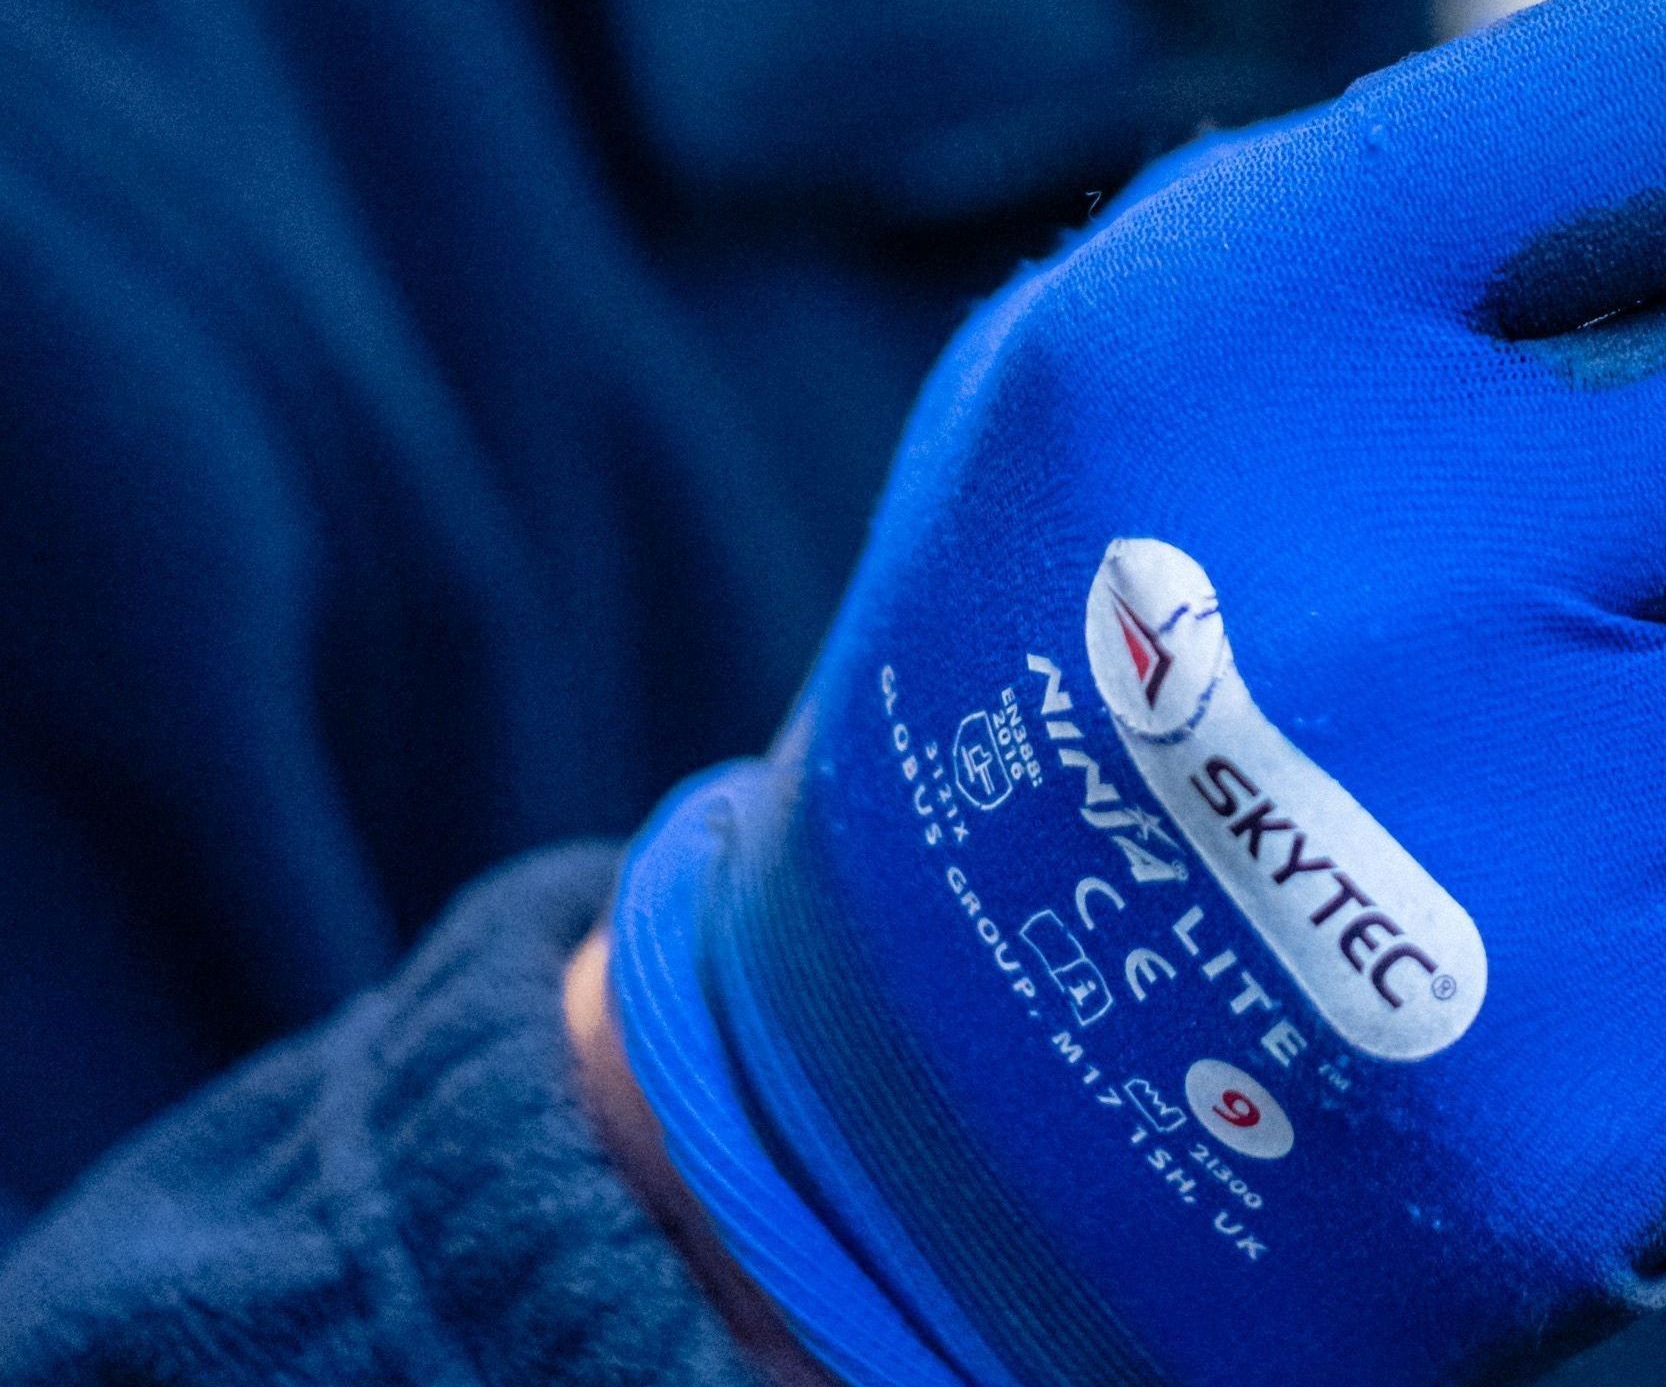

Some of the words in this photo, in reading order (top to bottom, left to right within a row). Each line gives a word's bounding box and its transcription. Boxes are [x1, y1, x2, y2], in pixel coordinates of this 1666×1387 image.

[992, 709, 1024, 781] 2016
[881, 664, 942, 845] GLOBUS
[1052, 1031, 1123, 1106] M17
[1214, 1211, 1268, 1261] UK
[1212, 1089, 1261, 1127] 9
[1189, 1143, 1263, 1209] 21300
